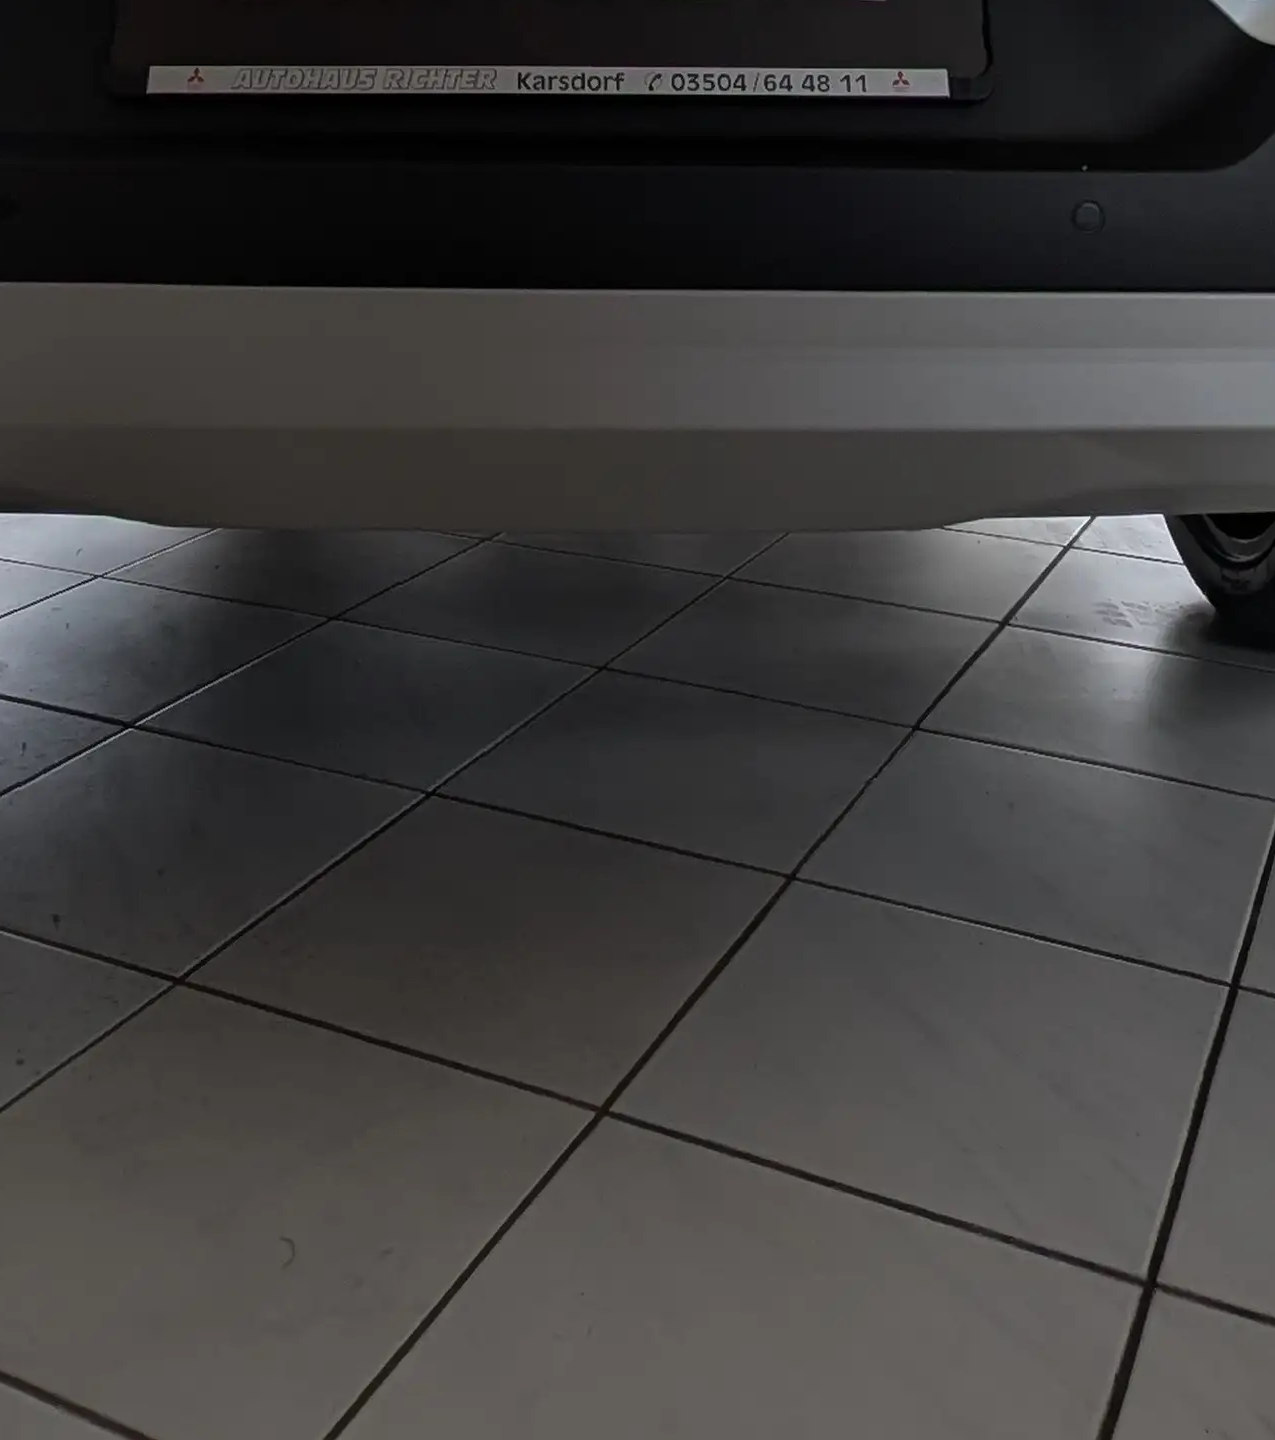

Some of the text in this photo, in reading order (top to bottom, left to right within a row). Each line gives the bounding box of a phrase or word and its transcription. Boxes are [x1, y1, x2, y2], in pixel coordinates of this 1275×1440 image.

[230, 68, 378, 91] AUTOHAUS
[382, 68, 498, 91] RICHTER
[516, 71, 625, 92] Karsdorf
[801, 74, 830, 93] 48
[839, 75, 868, 94] 11
